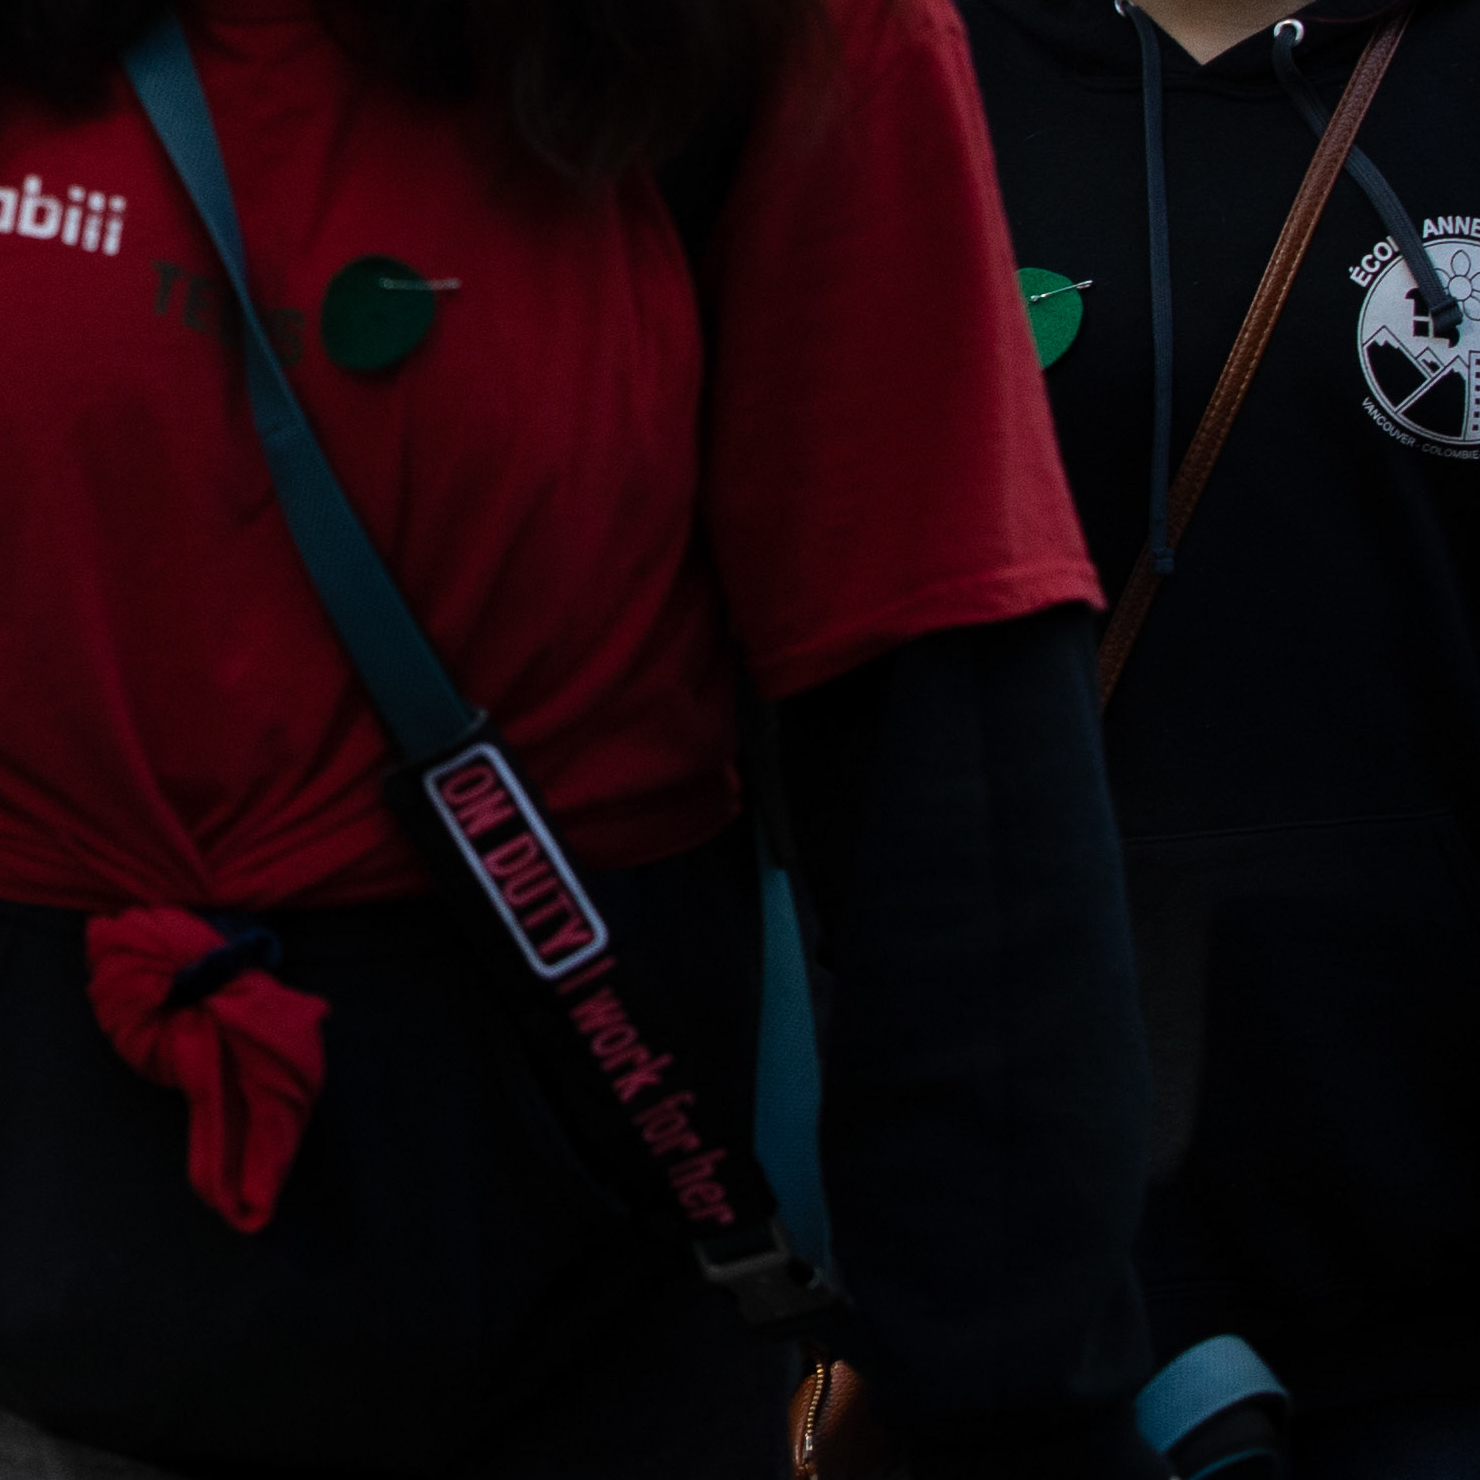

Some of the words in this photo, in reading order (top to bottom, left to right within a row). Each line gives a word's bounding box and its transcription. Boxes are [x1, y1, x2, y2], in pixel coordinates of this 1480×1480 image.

[1421, 215, 1480, 239] ANNE
[1361, 396, 1417, 449] VANCOUVER
[441, 764, 516, 839] ON
[482, 831, 593, 960] DUTY
[568, 985, 675, 1104] work
[630, 1087, 703, 1159] for
[665, 1146, 737, 1227] her
